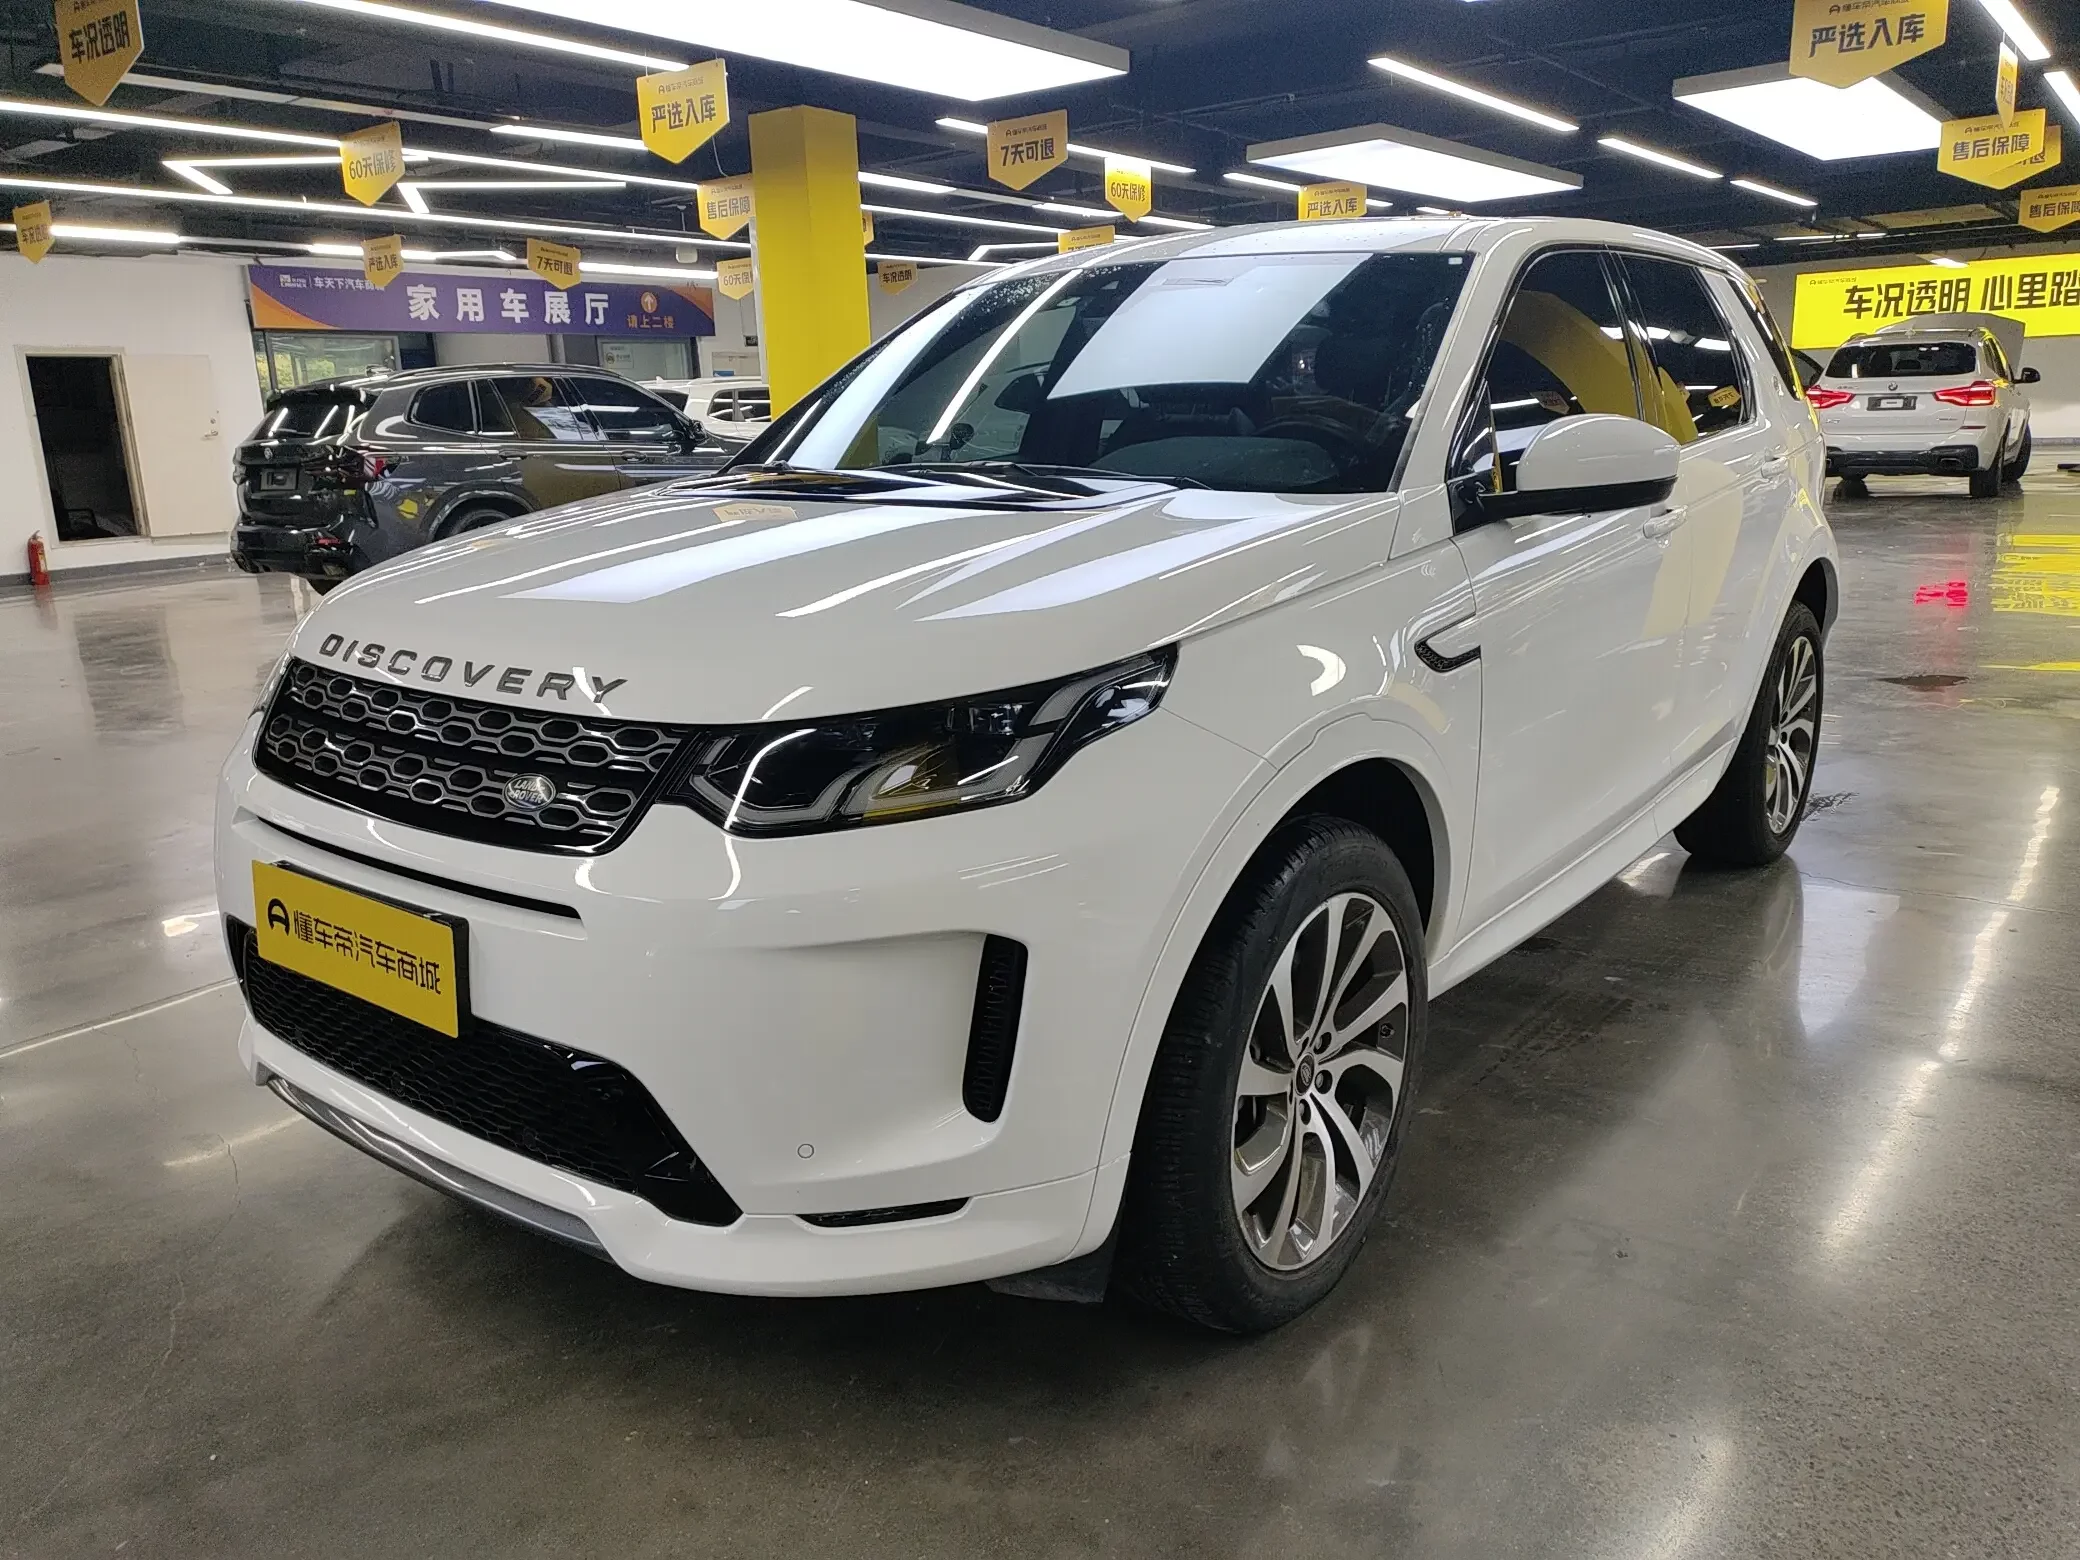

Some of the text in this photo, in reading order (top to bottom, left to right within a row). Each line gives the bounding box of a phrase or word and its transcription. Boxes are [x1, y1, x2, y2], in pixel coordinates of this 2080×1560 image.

[69, 10, 131, 64] 车况透明
[1808, 13, 1925, 58] 严选入库
[651, 94, 716, 133] 严选入库
[1001, 137, 1055, 166] 7天可退
[1952, 133, 2030, 162] 售后保障
[349, 149, 396, 180] 60天保修
[1110, 182, 1146, 202] 60天保修
[706, 196, 751, 220] 售后保障
[1307, 197, 1358, 218] 严选入库
[368, 253, 398, 273] 严选入库
[536, 255, 573, 276] 7天可退
[405, 283, 610, 325] 家用车展厅
[1843, 277, 1972, 319] 车况透明
[626, 314, 675, 329] 请上二楼
[319, 632, 628, 704] DISCOVERY
[513, 788, 545, 804] ROVER
[293, 910, 442, 995] 懂车帝汽车商城
